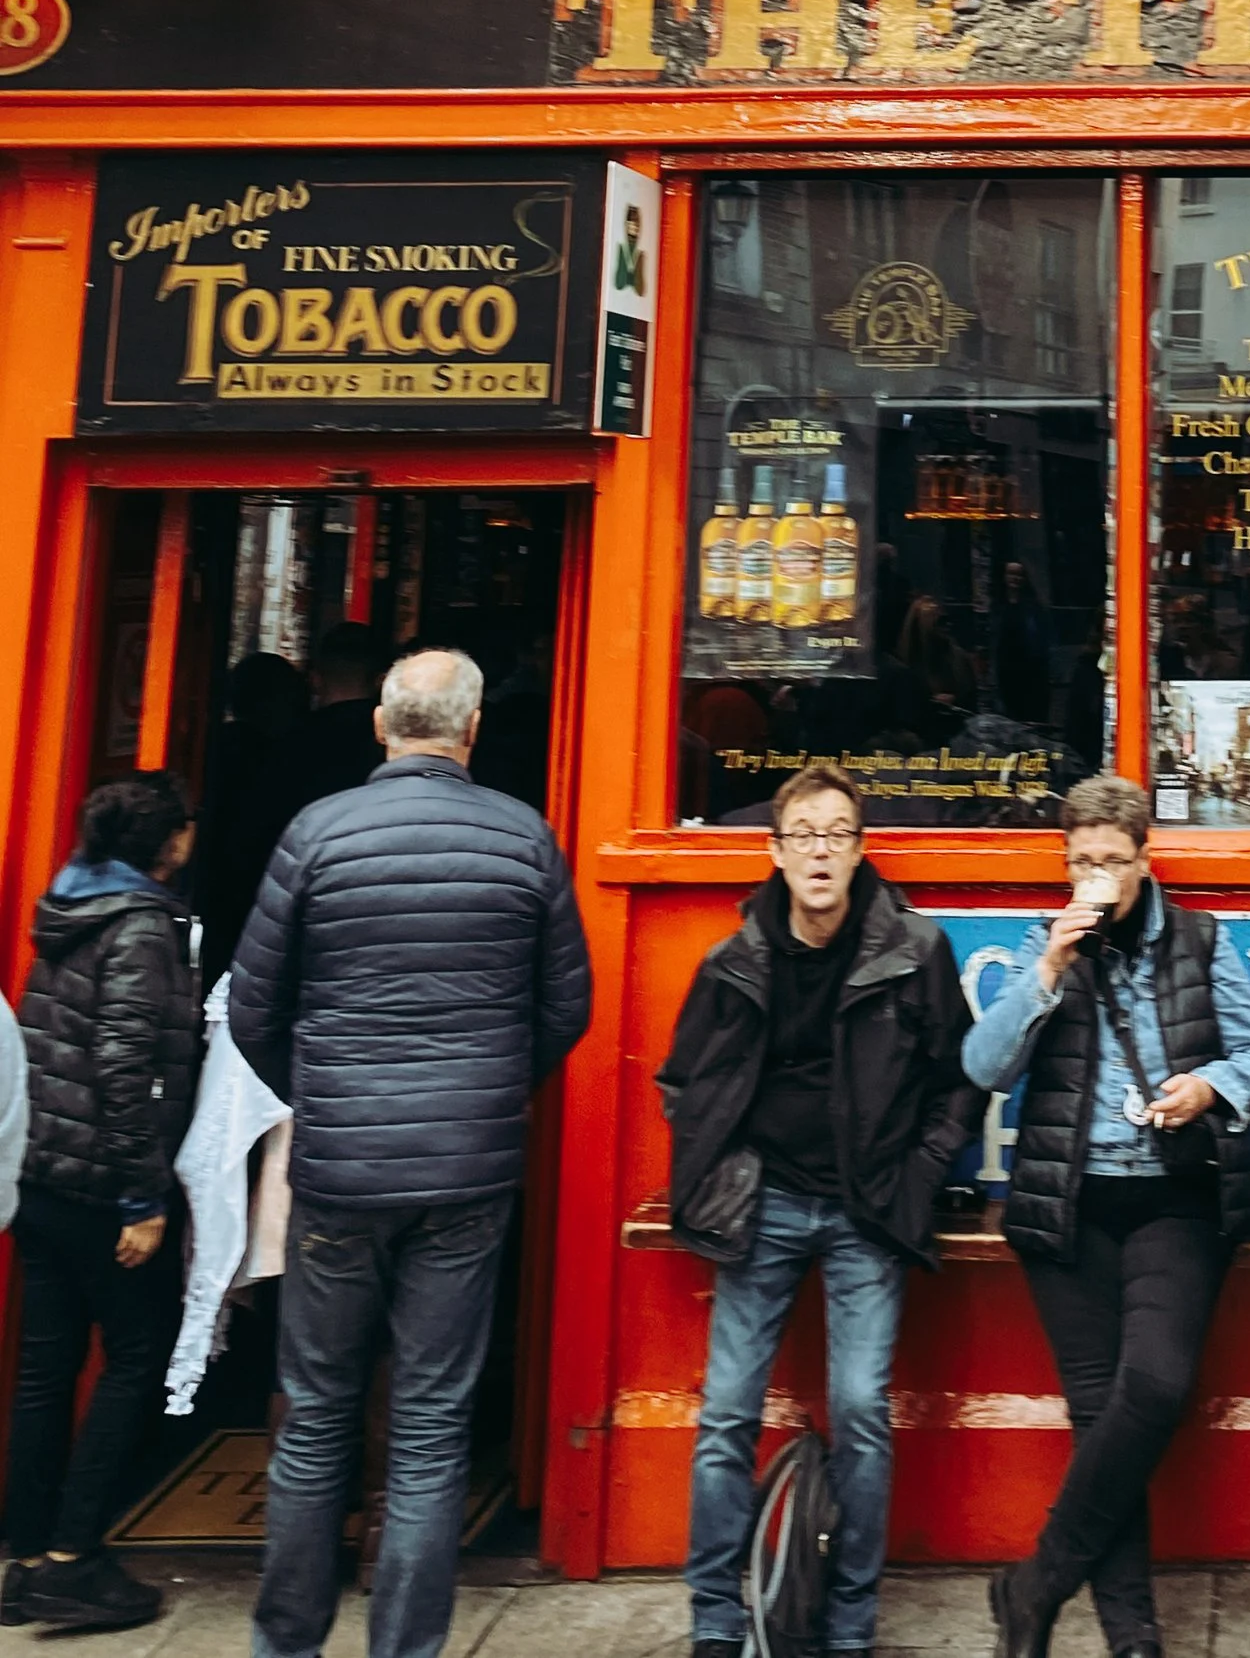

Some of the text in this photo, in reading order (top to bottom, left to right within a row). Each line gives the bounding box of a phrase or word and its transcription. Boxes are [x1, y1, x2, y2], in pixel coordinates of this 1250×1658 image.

[109, 179, 311, 263] Importers
[231, 228, 271, 251] OF
[281, 243, 520, 274] FINE SMOKING
[155, 263, 518, 386] TOBACCO
[222, 363, 543, 397] Always in Stock
[1170, 413, 1241, 439] Fresh
